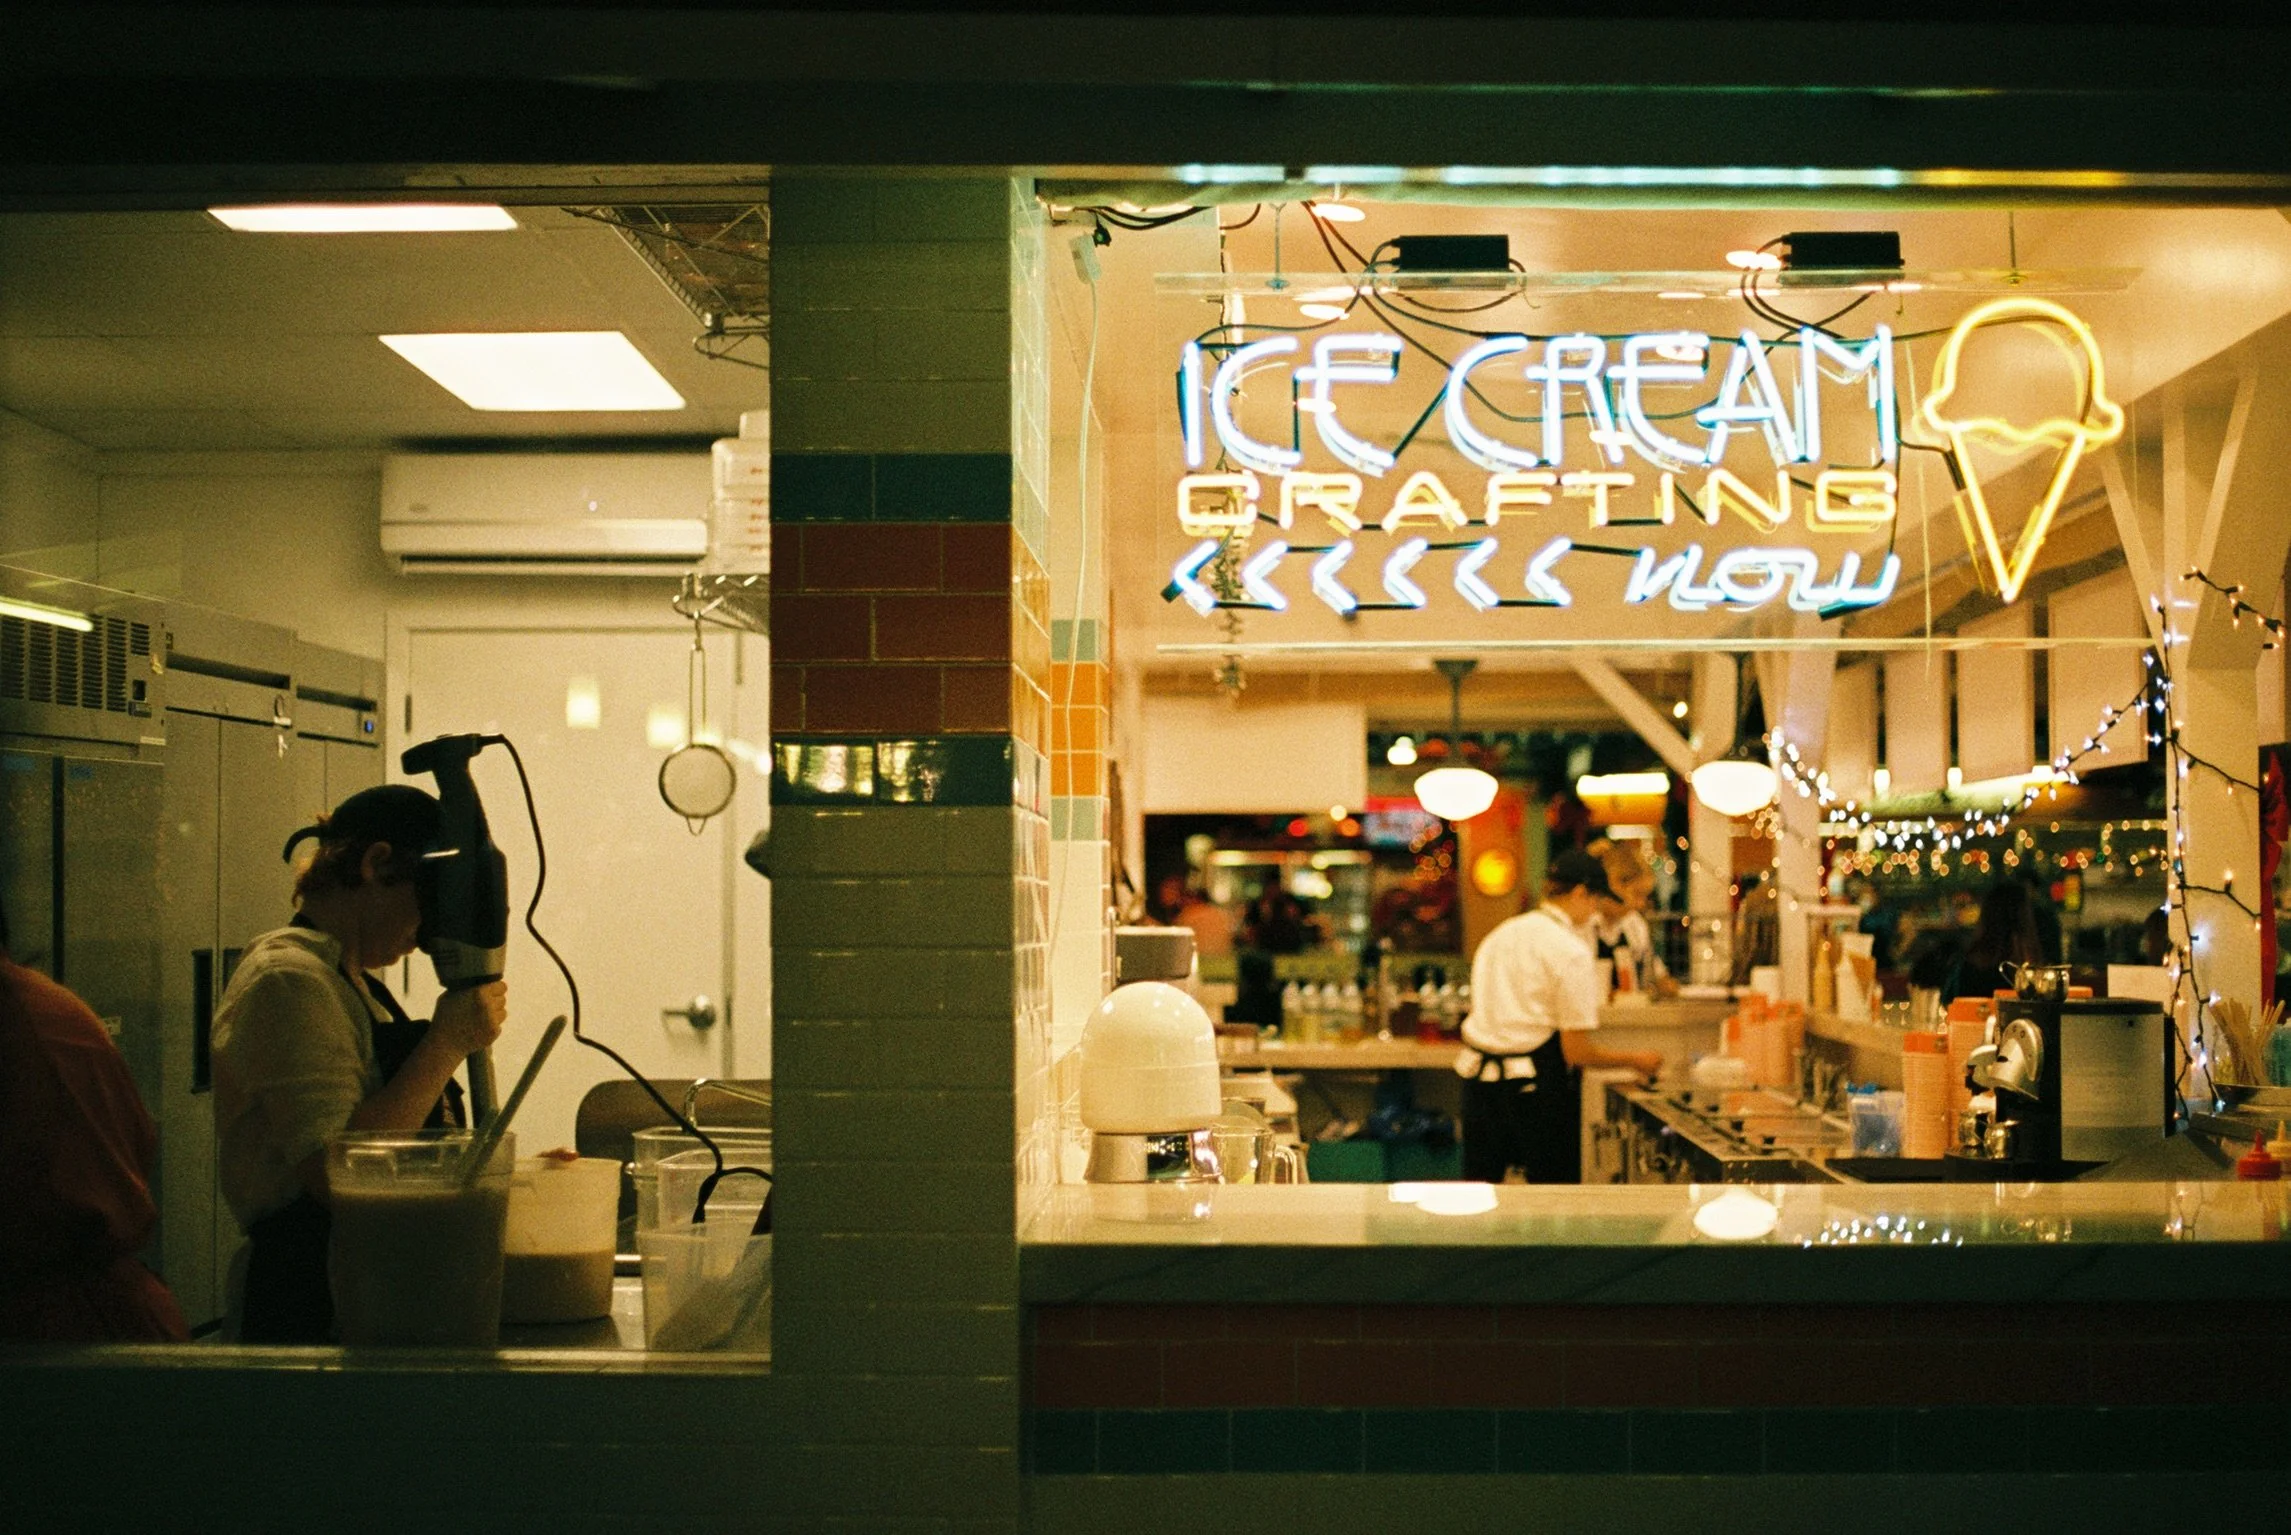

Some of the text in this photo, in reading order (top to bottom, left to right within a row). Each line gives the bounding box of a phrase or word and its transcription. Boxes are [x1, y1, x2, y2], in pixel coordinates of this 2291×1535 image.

[1182, 325, 1897, 471] ICE CREAM
[1177, 470, 1897, 532] CRAFTING
